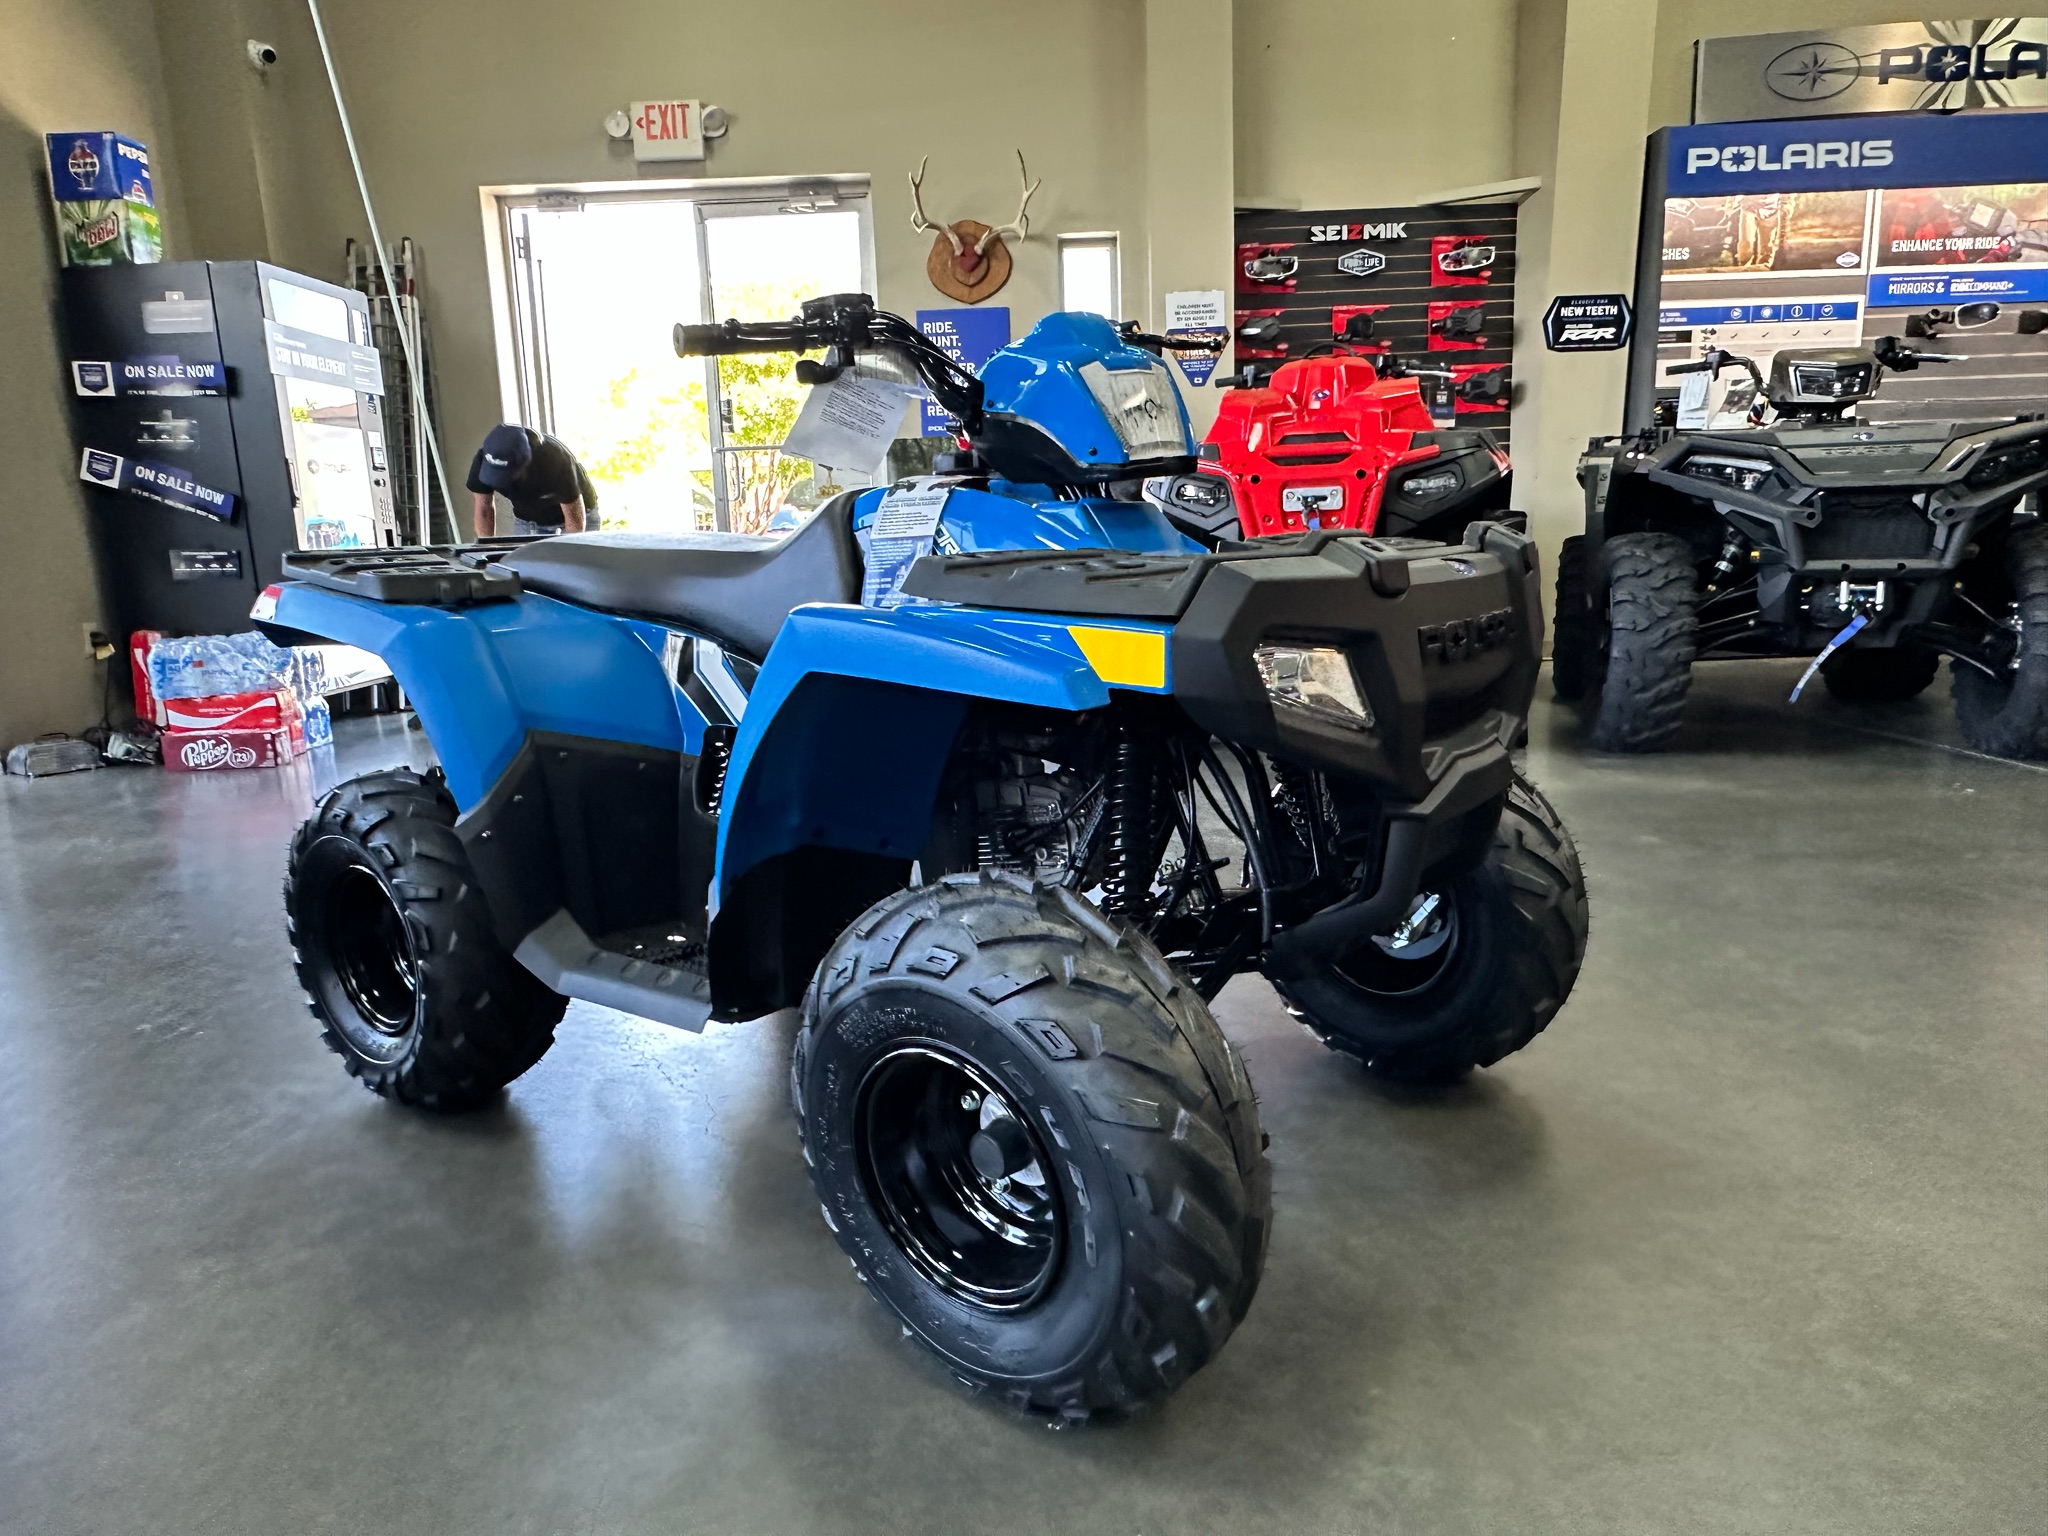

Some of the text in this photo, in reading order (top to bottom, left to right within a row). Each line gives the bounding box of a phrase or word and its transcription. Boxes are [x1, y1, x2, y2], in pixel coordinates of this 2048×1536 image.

[645, 104, 689, 139] EXIT
[1686, 139, 1893, 174] POLARIS
[1310, 222, 1408, 242] SEIZMIK
[1891, 236, 2002, 253] ENHANCE YOUR RIDE
[1888, 282, 1935, 295] MIRRORS
[1560, 305, 1618, 317] NEW TEETH
[923, 322, 957, 334] RIDE.
[1559, 328, 1617, 343] RZR
[125, 364, 215, 378] ON SALE NOW
[135, 465, 156, 482] ON
[156, 472, 195, 495] SALE
[194, 483, 225, 506] NOW
[200, 738, 216, 752] Dr
[187, 743, 229, 767] Pepper
